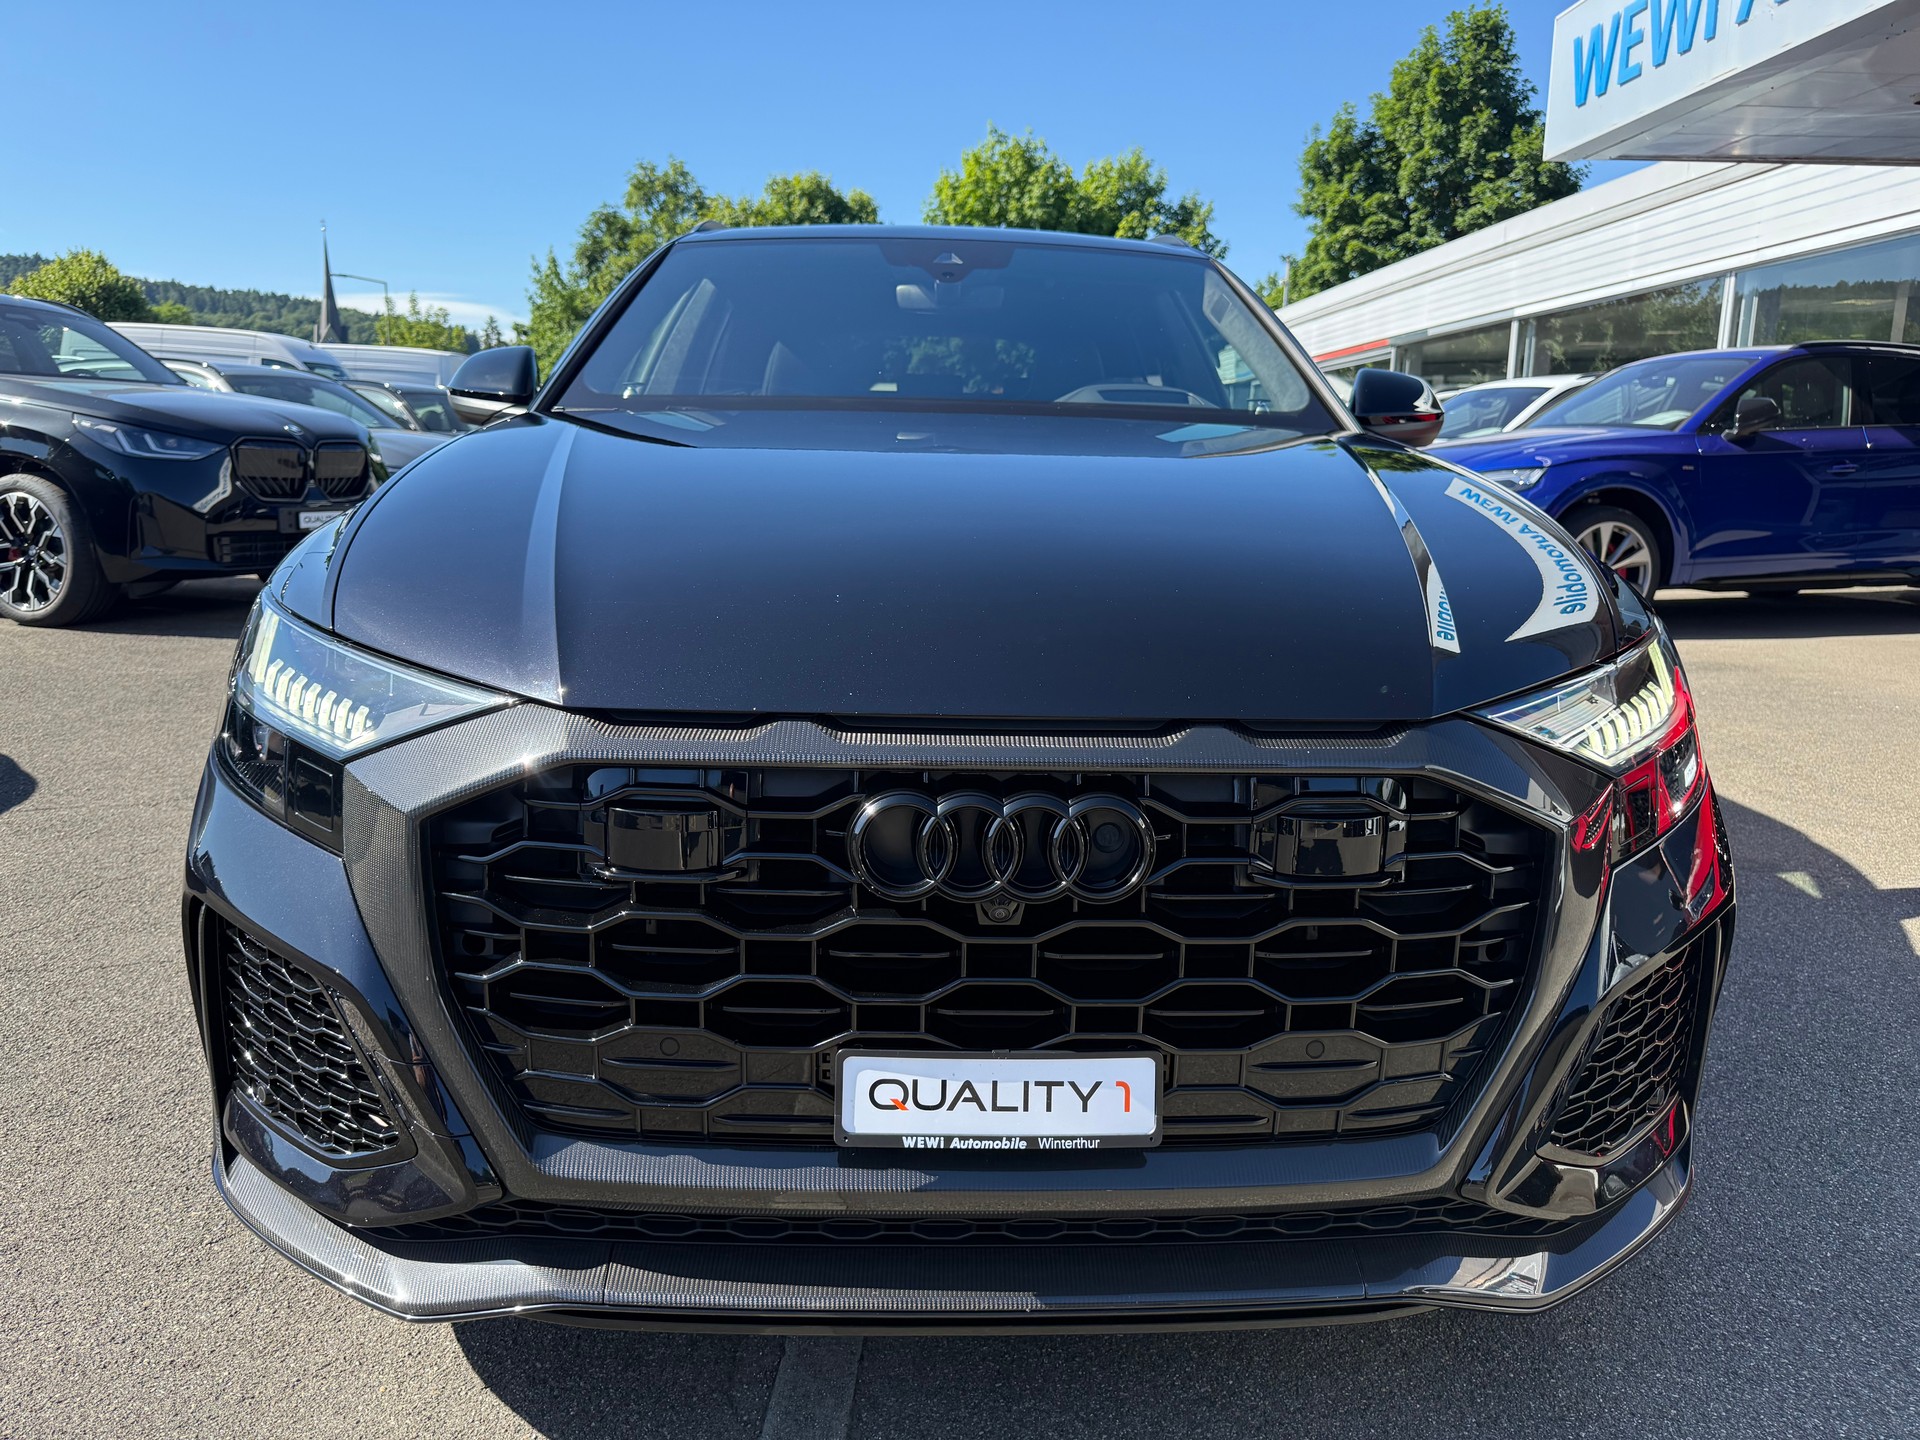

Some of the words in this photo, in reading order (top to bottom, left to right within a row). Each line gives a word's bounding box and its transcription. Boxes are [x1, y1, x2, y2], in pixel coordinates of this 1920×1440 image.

[868, 1079, 1103, 1113] QUALITY
[1115, 1081, 1131, 1113] 1
[902, 1136, 944, 1149] WEWi
[949, 1137, 1028, 1150] Automobile
[1037, 1137, 1100, 1149] Winterthur
